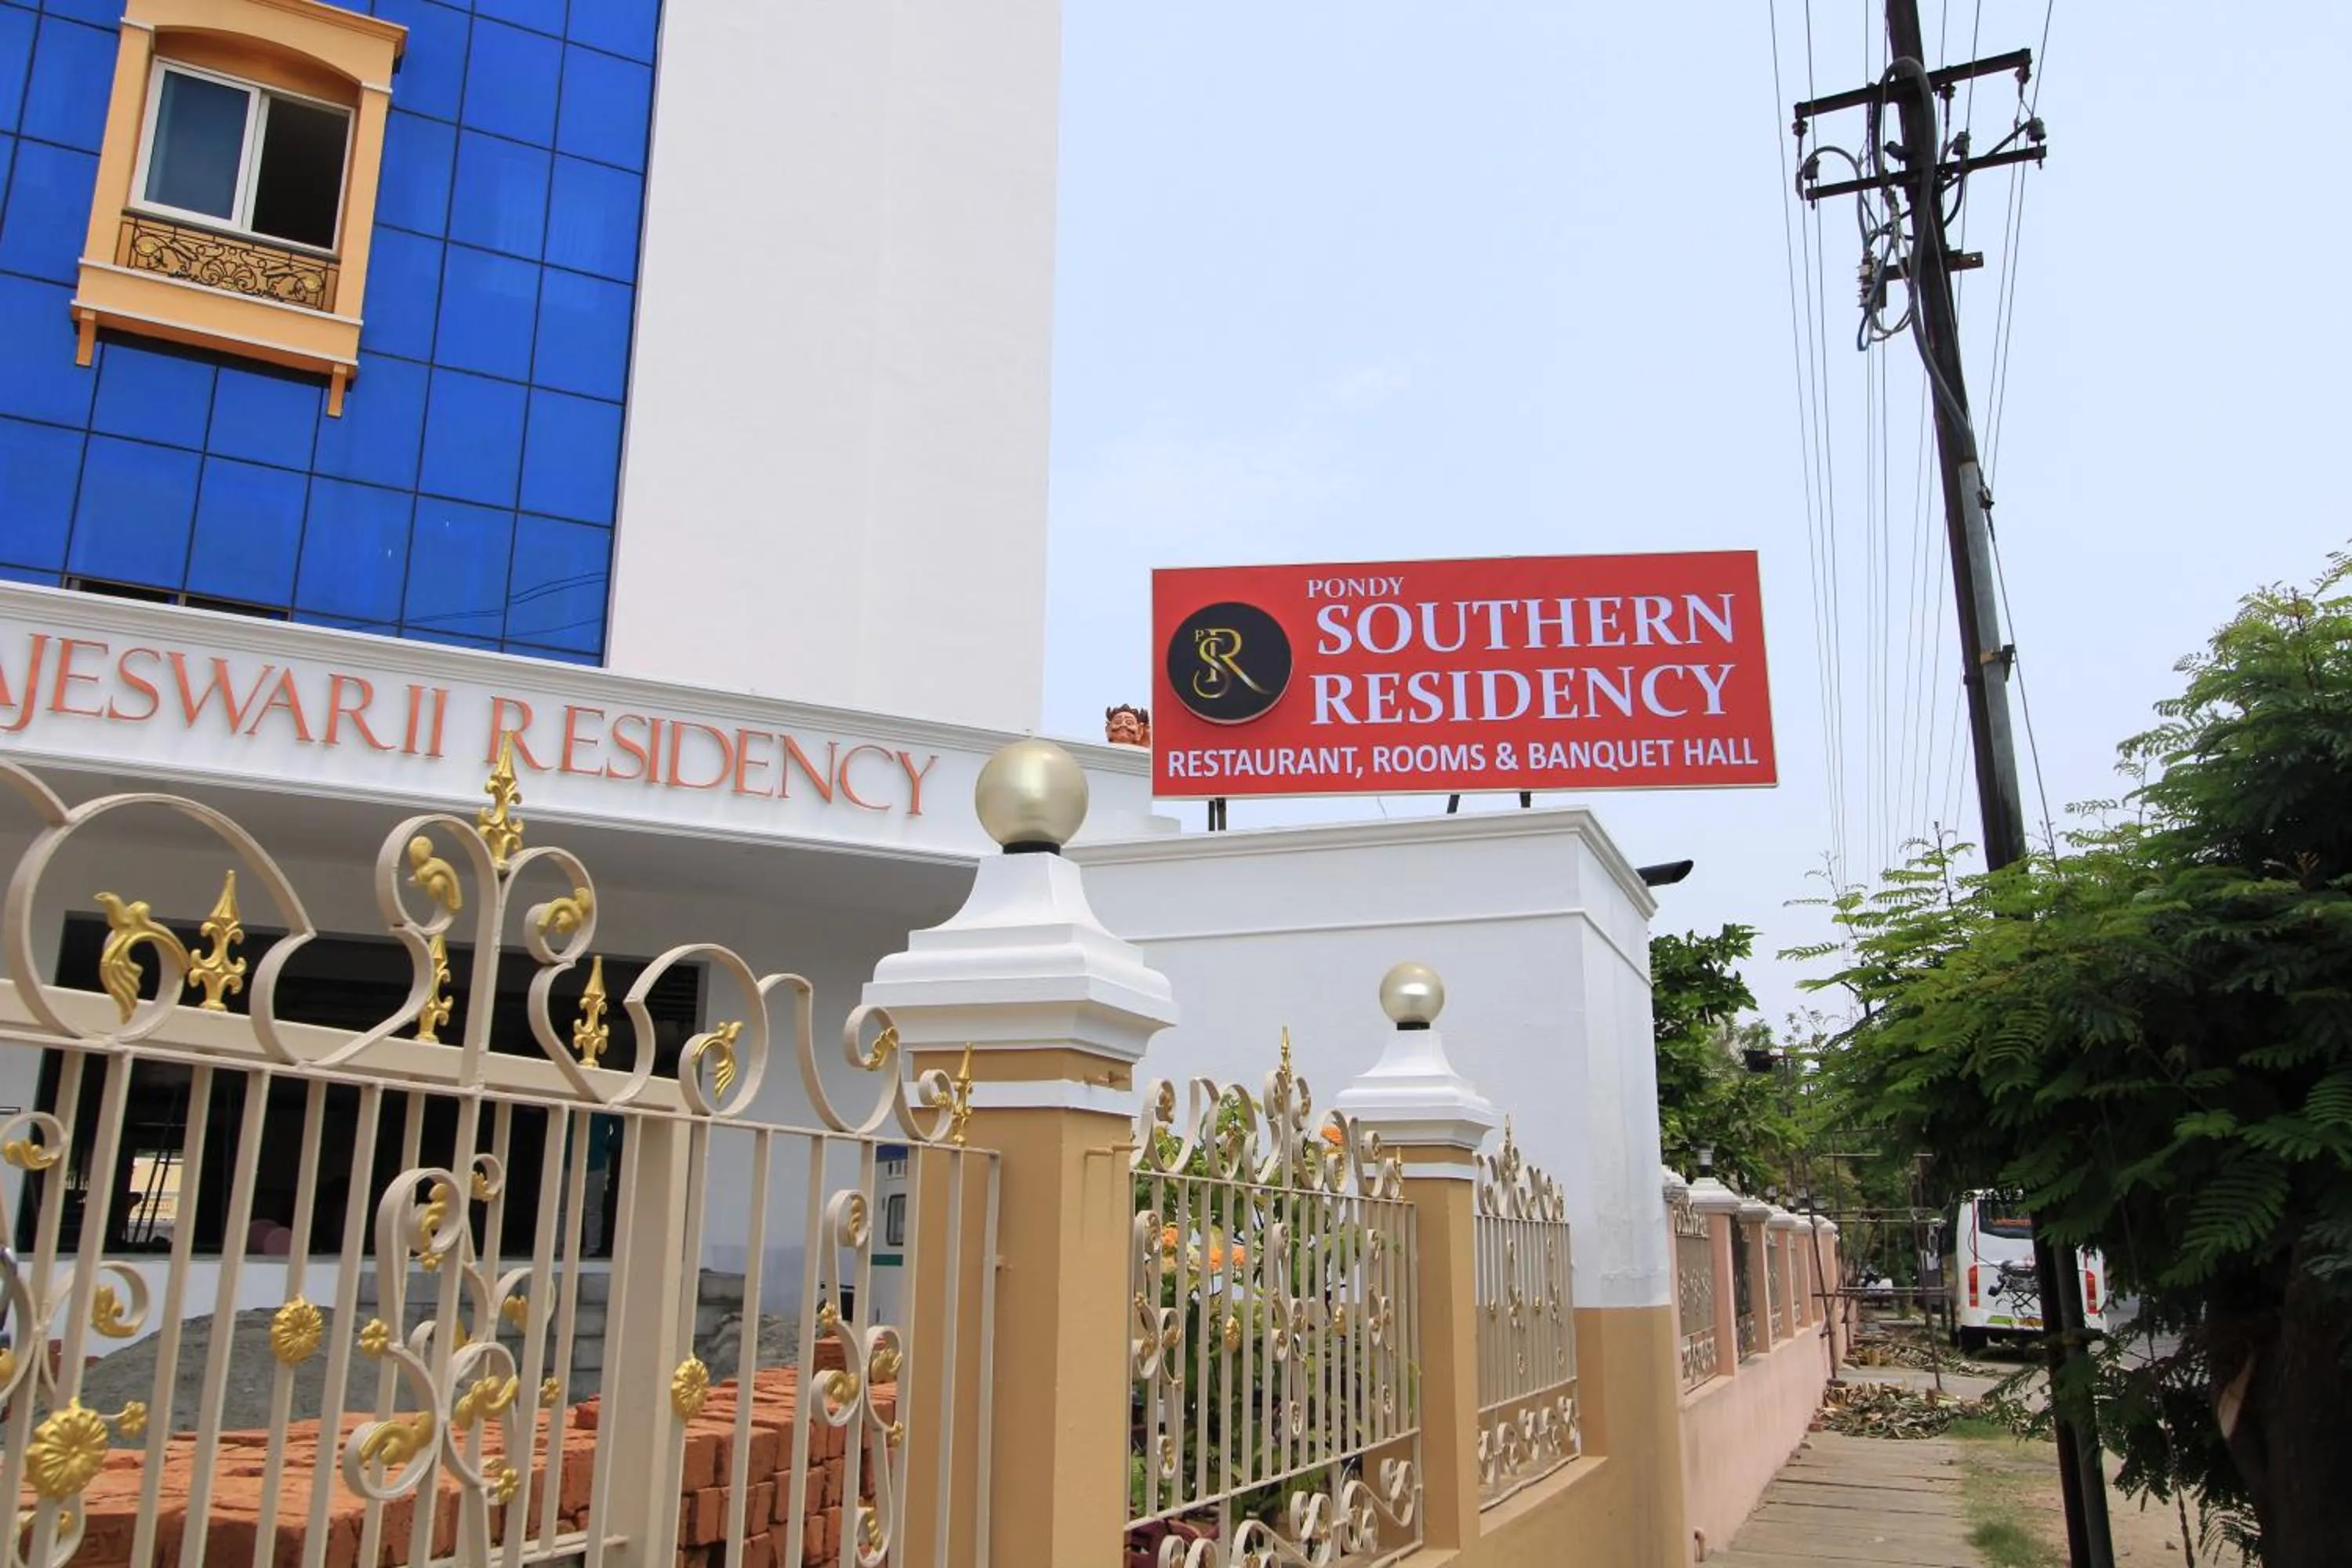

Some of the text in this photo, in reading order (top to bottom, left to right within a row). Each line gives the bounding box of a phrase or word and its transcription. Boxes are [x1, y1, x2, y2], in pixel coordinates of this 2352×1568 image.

[1307, 577, 1405, 599] PONDY
[1316, 593, 1735, 655] SOUTHERN
[0, 633, 939, 816] JESWARII RESIDENCY
[1309, 664, 1734, 726] RESIDENCY
[1168, 737, 1759, 779] RESTAURANT, ROOMS & BANQUET HALL
